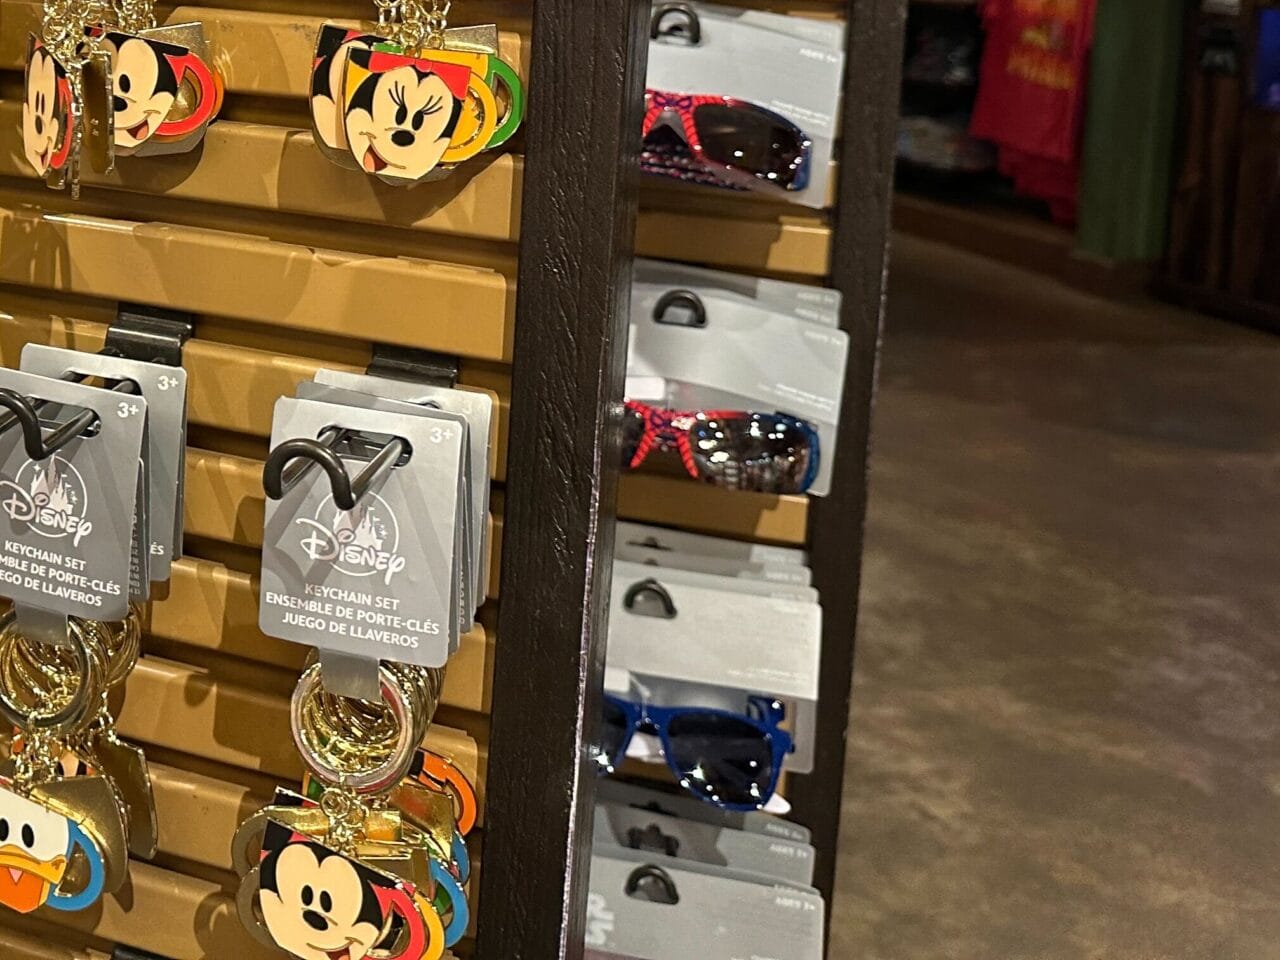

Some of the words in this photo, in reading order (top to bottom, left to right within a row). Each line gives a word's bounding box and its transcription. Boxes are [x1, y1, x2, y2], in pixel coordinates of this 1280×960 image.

[157, 375, 179, 390] 3+
[117, 402, 139, 418] 3+
[429, 427, 454, 444] 3+
[0, 480, 92, 548] Disney
[5, 540, 63, 565] KEYCHAIN
[65, 556, 86, 571] SET
[295, 518, 405, 585] Disney
[24, 576, 40, 590] DE
[42, 582, 102, 607] LLAVEROS
[30, 565, 46, 577] DE
[49, 569, 120, 595] PORTE-CLÉS
[305, 583, 372, 605] KEYCHAIN
[375, 596, 399, 610] SET
[266, 592, 332, 615] ENSEMBLE
[335, 605, 353, 619] DE
[357, 610, 440, 635] PORTE-CLÉS
[282, 612, 326, 630] JUEGO
[329, 621, 347, 635] DE
[350, 625, 420, 648] LLAVEROS
